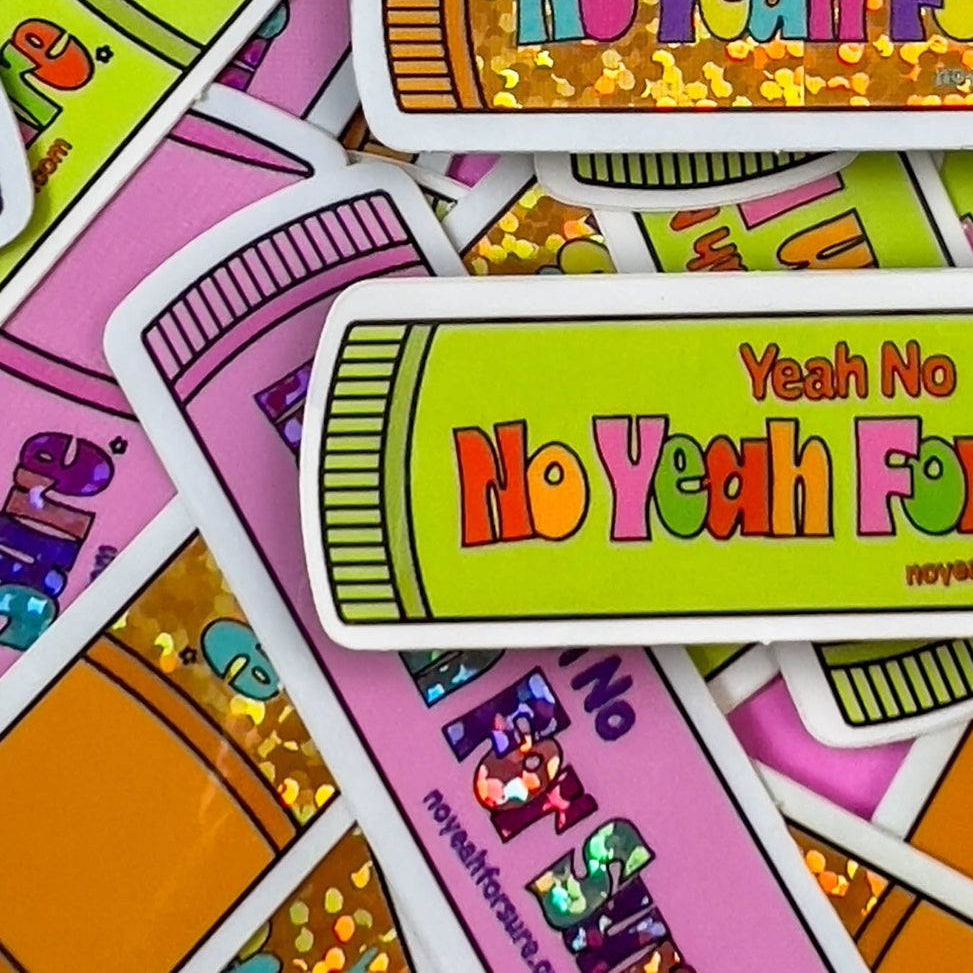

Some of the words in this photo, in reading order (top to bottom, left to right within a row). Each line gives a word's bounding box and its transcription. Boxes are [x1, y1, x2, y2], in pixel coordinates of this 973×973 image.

[739, 340, 869, 402] Yeah
[880, 338, 957, 400] No
[452, 418, 591, 548] No
[592, 414, 835, 543] Yeah
[569, 654, 637, 742] No
[441, 664, 599, 845] For
